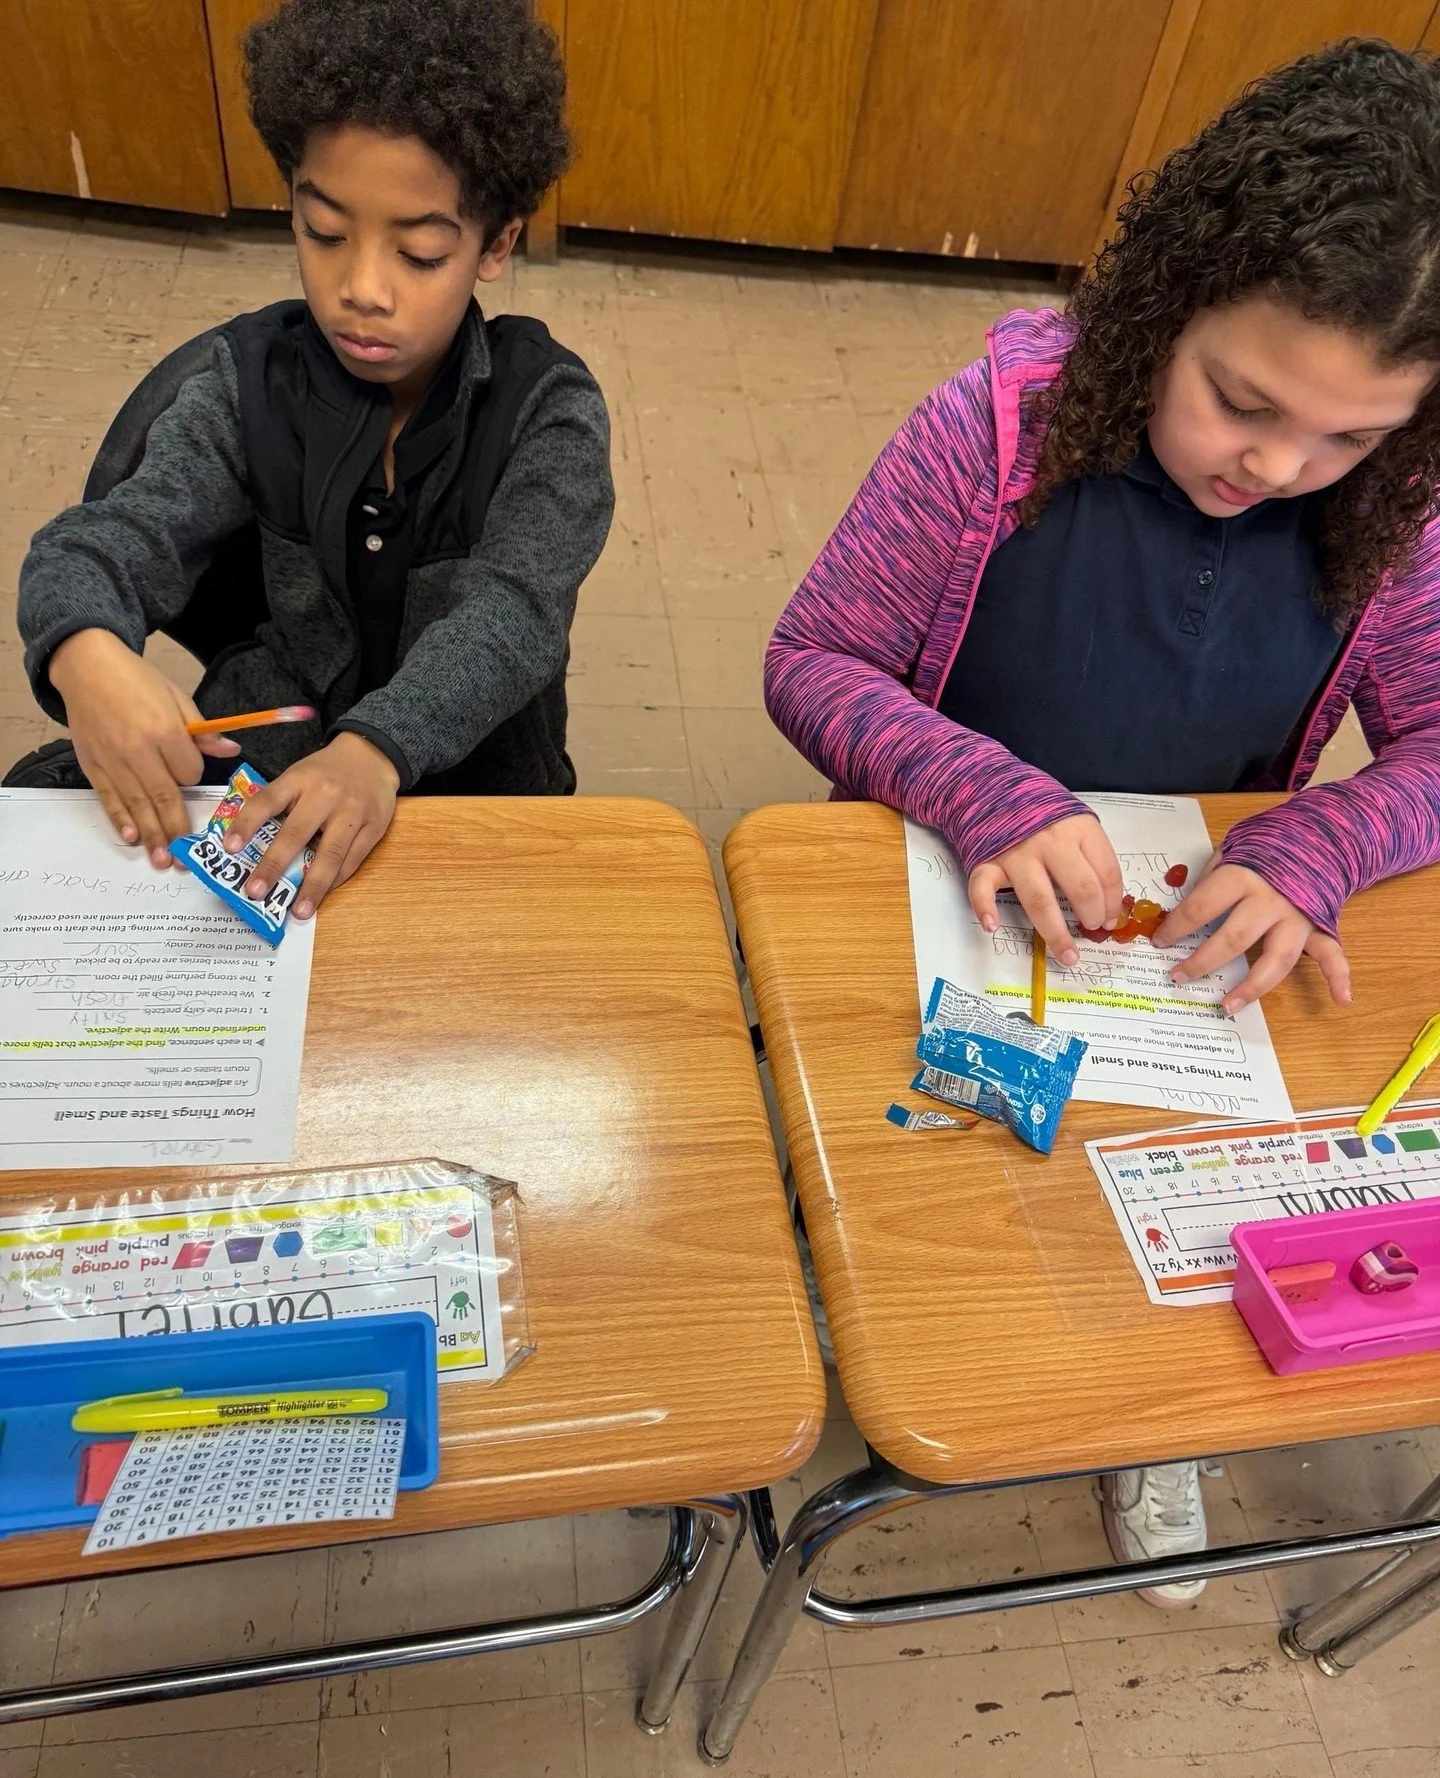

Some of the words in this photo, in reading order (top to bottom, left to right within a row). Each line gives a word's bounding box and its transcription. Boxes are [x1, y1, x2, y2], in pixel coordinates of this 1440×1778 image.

[194, 840, 290, 921] Wlch's
[13, 913, 56, 922] correctly.
[172, 915, 212, 923] describe
[64, 925, 88, 933] draft
[128, 924, 164, 933] writing.
[166, 925, 189, 933] your
[191, 926, 200, 934] of
[202, 926, 226, 934] piece
[164, 941, 194, 949] candy.
[1112, 950, 1131, 958] filled
[1132, 952, 1164, 961] perfume
[74, 956, 107, 965] picked.
[134, 956, 160, 965] ready
[180, 957, 211, 966] berries
[1127, 965, 1147, 973] fresh
[1148, 967, 1161, 975] the
[166, 972, 206, 981] perfume
[208, 972, 237, 981] strong
[153, 990, 175, 999] fresh
[1085, 989, 1124, 997] adjective.
[1085, 998, 1122, 1008] adjective
[143, 1005, 181, 1016] pretzels.
[183, 1006, 205, 1016] salty
[208, 1007, 225, 1015] the
[227, 1007, 248, 1015] tried
[1139, 1005, 1155, 1013] find
[1156, 1007, 1194, 1016] sentence,
[1195, 1011, 1215, 1019] each
[85, 1026, 132, 1035] adjective.
[213, 1025, 266, 1034] underlined
[1148, 1028, 1175, 1037] smells.
[79, 1038, 124, 1048] adjective
[1118, 1034, 1142, 1044] about
[1144, 1038, 1164, 1046] more
[33, 1041, 54, 1049] tells
[1166, 1041, 1182, 1049] tells
[1184, 1042, 1222, 1053] adjective
[1091, 1056, 1124, 1066] Smell
[1127, 1059, 1148, 1070] and
[146, 1066, 179, 1074] smells.
[1152, 1062, 1182, 1074] Taste
[1184, 1066, 1223, 1078] Things
[1226, 1071, 1251, 1082] How
[10, 1080, 61, 1090] Adjectives
[101, 1081, 131, 1089] about
[163, 1080, 182, 1088] tells
[185, 1078, 232, 1088] adjective
[54, 1110, 96, 1121] Smell
[100, 1110, 128, 1121] and
[131, 1109, 169, 1120] Taste
[173, 1107, 219, 1119] Things
[223, 1108, 255, 1118] How
[1397, 1122, 1423, 1131] rectangle
[1228, 1139, 1253, 1154] pink
[1258, 1136, 1295, 1153] purple
[1183, 1144, 1224, 1158] brown
[1145, 1150, 1178, 1163] black
[1234, 1154, 1274, 1166] orange
[1281, 1153, 1302, 1164] red
[1191, 1156, 1229, 1171] yellow
[1118, 1169, 1144, 1180] blue
[1150, 1162, 1184, 1177] green
[1135, 1212, 1157, 1224] right
[75, 1240, 109, 1259] pink
[118, 1234, 169, 1255] purple
[11, 1248, 64, 1262] brown
[1203, 1255, 1225, 1265] Ww
[71, 1260, 130, 1275] orange
[140, 1256, 168, 1271] red
[1152, 1263, 1167, 1273] Zz
[1168, 1258, 1184, 1271] Yy
[1185, 1258, 1202, 1268] Xx
[450, 1276, 468, 1287] left
[438, 1334, 456, 1346] Bb
[460, 1331, 481, 1344] Aa
[197, 1509, 213, 1517] 17
[227, 1505, 242, 1513] 16
[138, 1517, 155, 1526] 19
[168, 1513, 184, 1521] 18
[104, 1522, 123, 1532] 20
